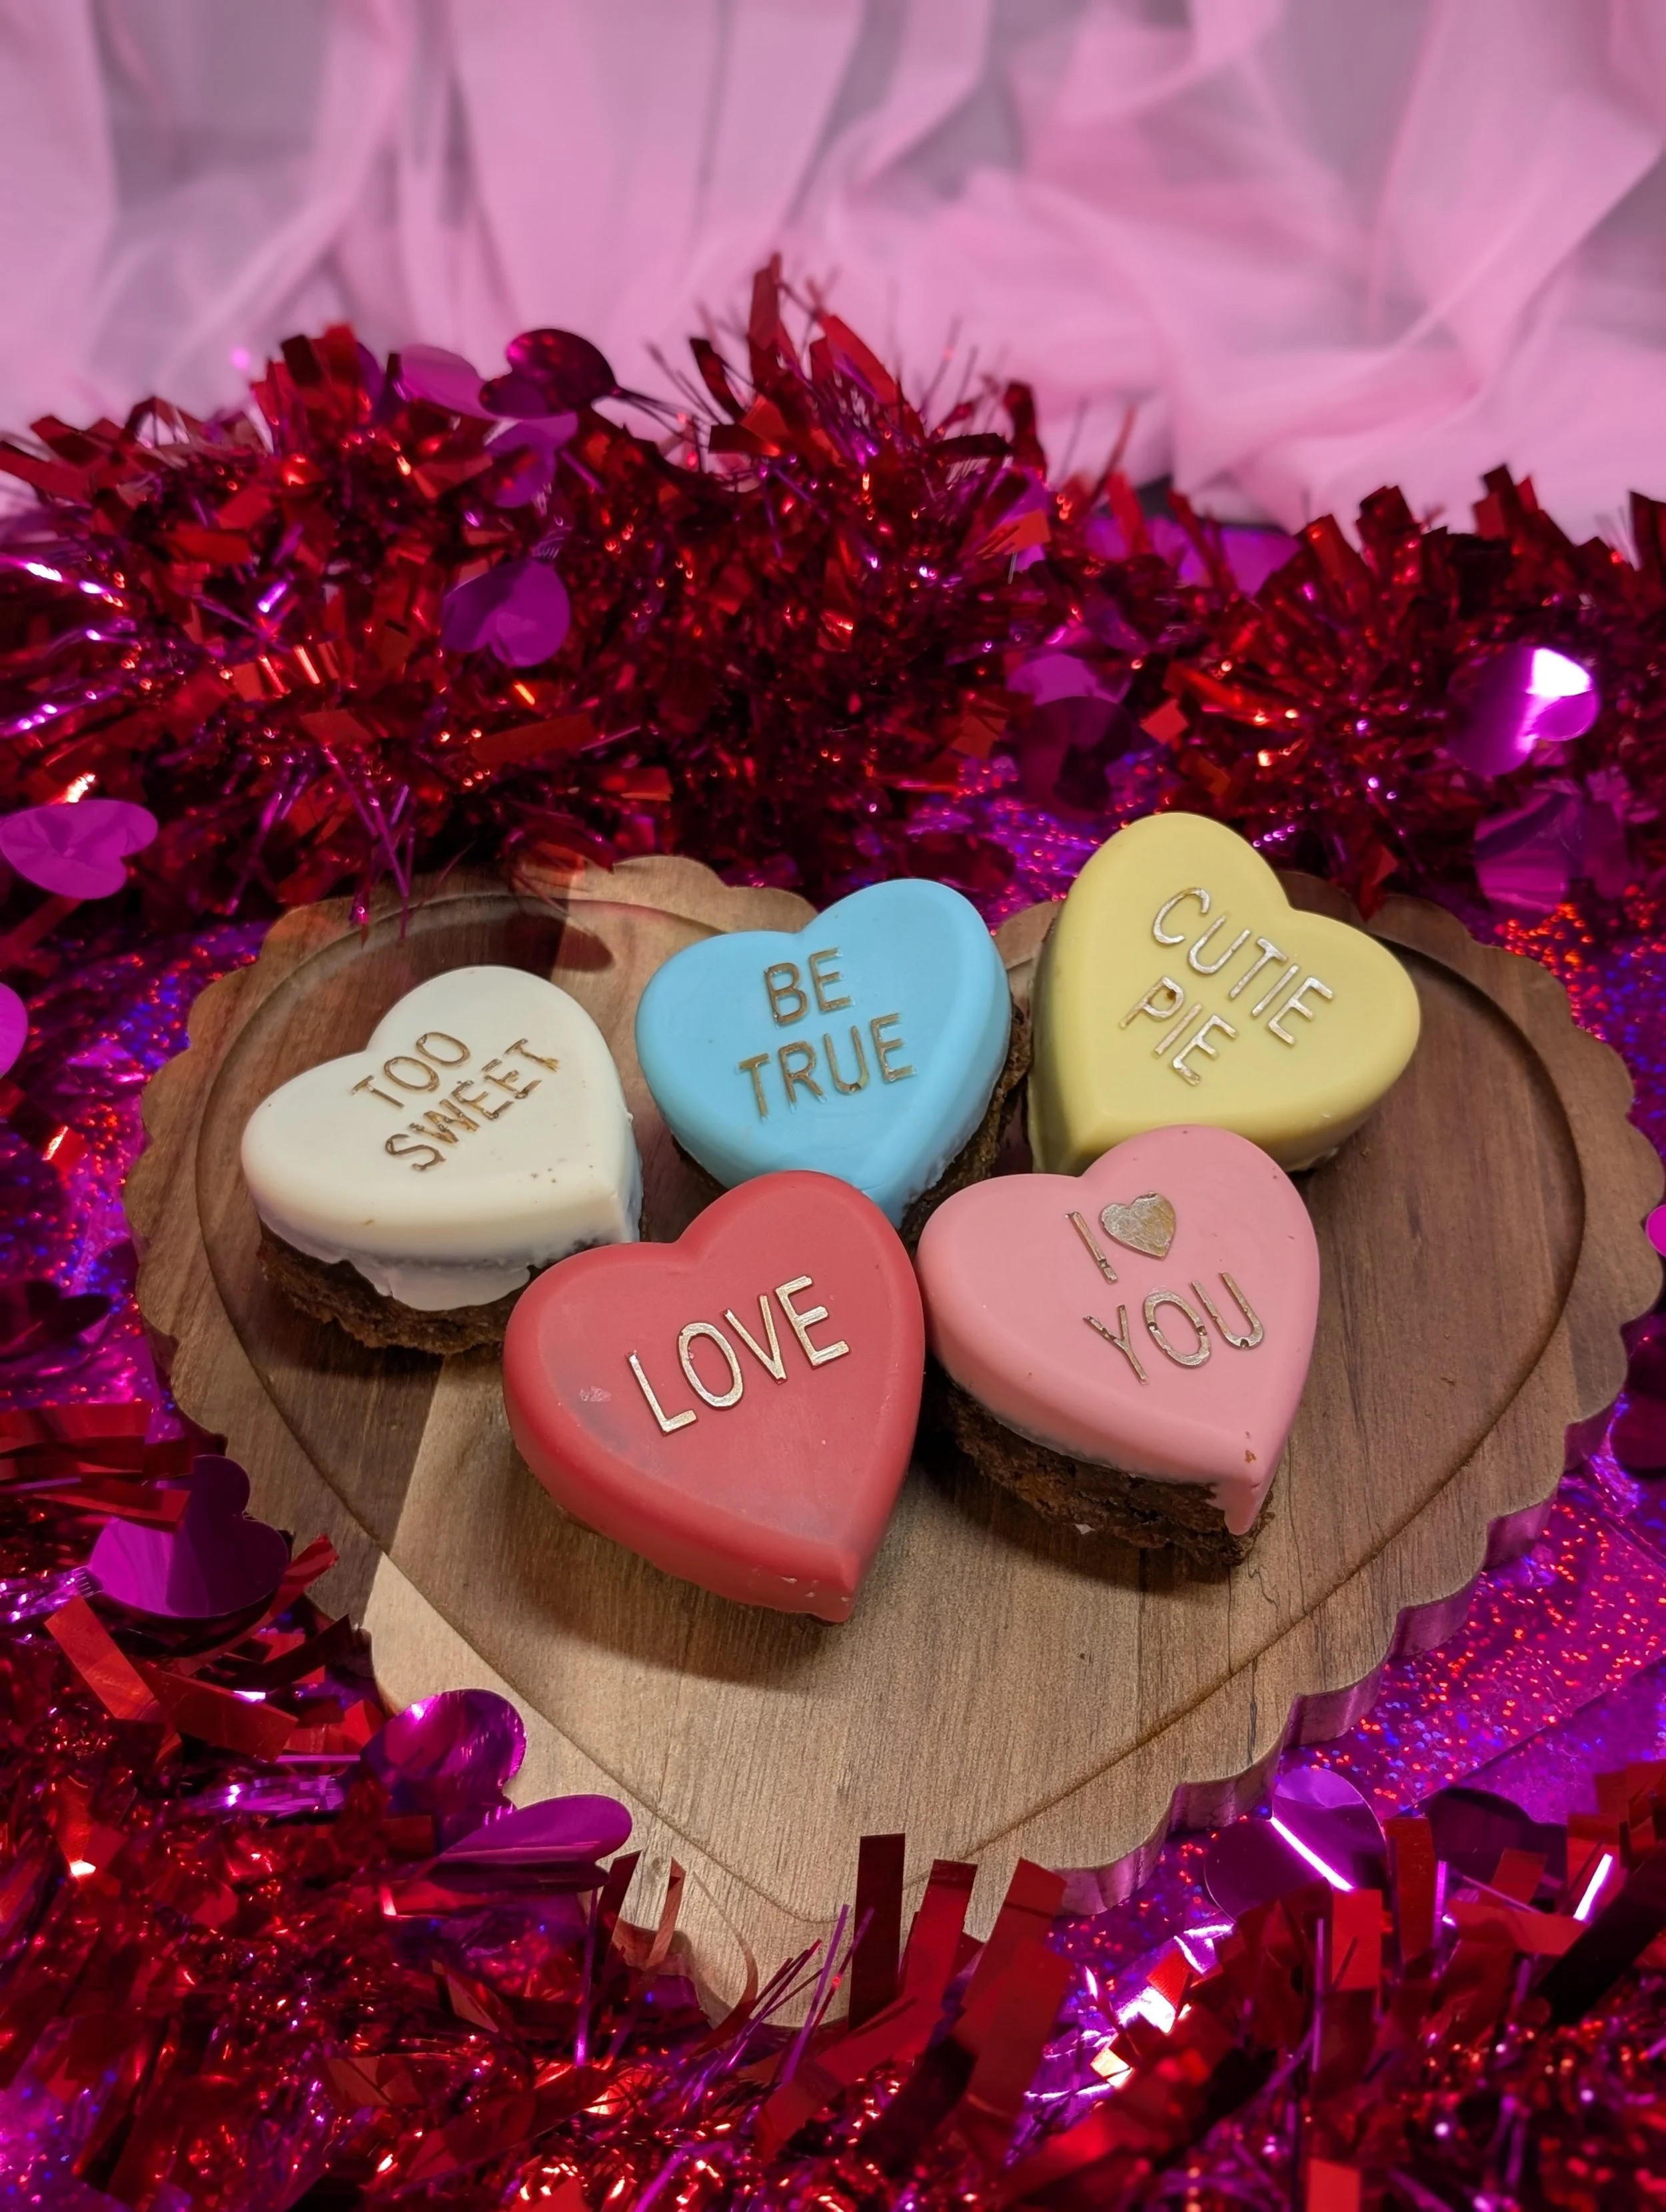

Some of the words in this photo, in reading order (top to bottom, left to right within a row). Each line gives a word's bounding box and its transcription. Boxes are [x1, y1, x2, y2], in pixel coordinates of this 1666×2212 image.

[764, 947, 855, 1027] BE
[1152, 887, 1333, 1046] CUTIE
[352, 1031, 470, 1109] TOO
[736, 1013, 917, 1122] TRUE
[1119, 975, 1237, 1085] PIE
[385, 1038, 560, 1171] SWEET
[1067, 1211, 1118, 1283] I
[626, 1275, 850, 1436] LOVE
[1083, 1271, 1263, 1384] YOU
